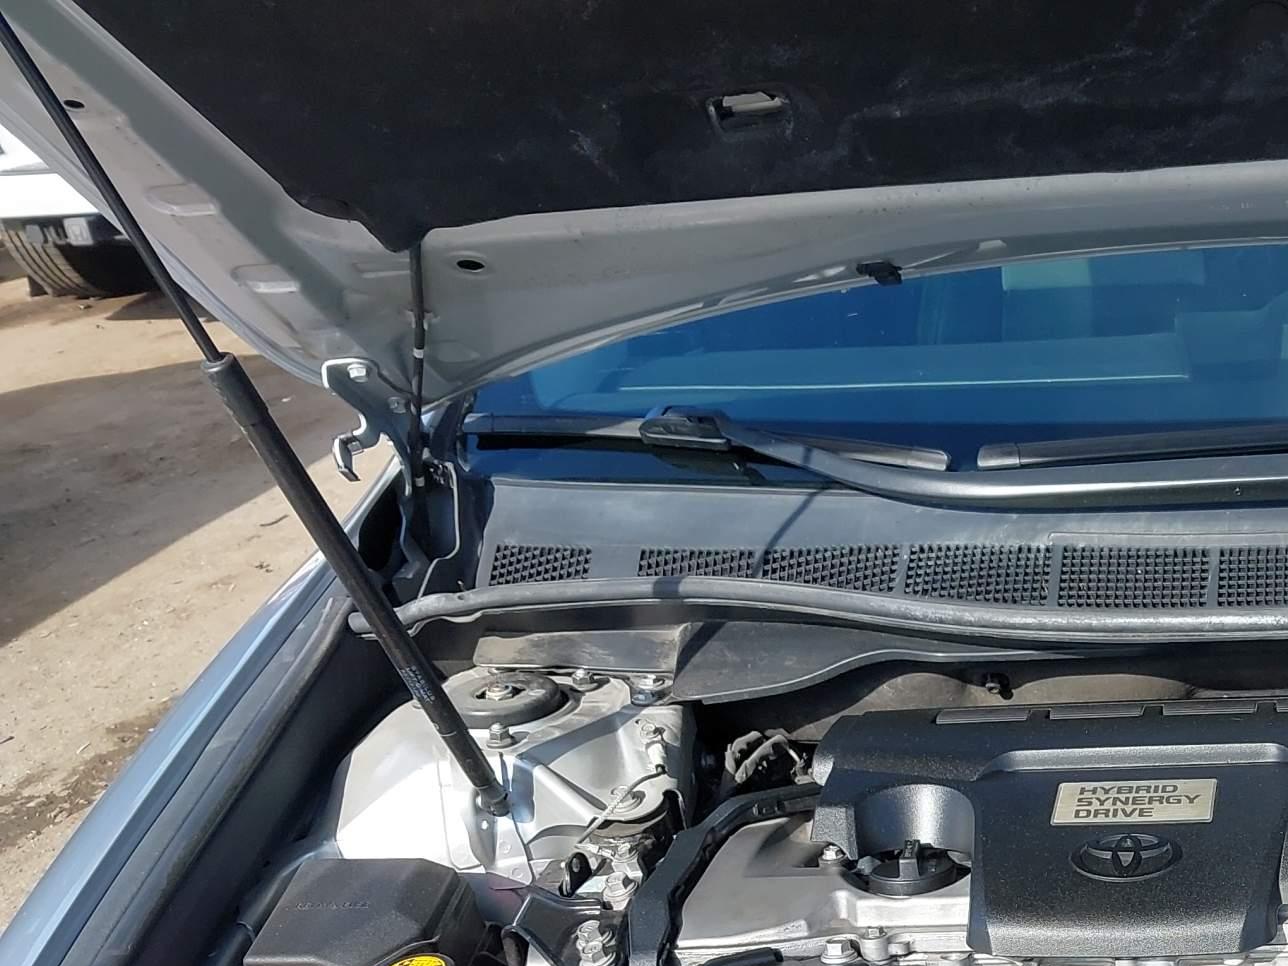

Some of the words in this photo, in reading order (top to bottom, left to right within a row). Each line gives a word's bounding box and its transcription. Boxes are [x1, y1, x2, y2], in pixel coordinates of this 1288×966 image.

[1078, 784, 1179, 796] HYBRID
[1075, 794, 1201, 808] SYNERGY
[1073, 806, 1155, 819] DRIVE
